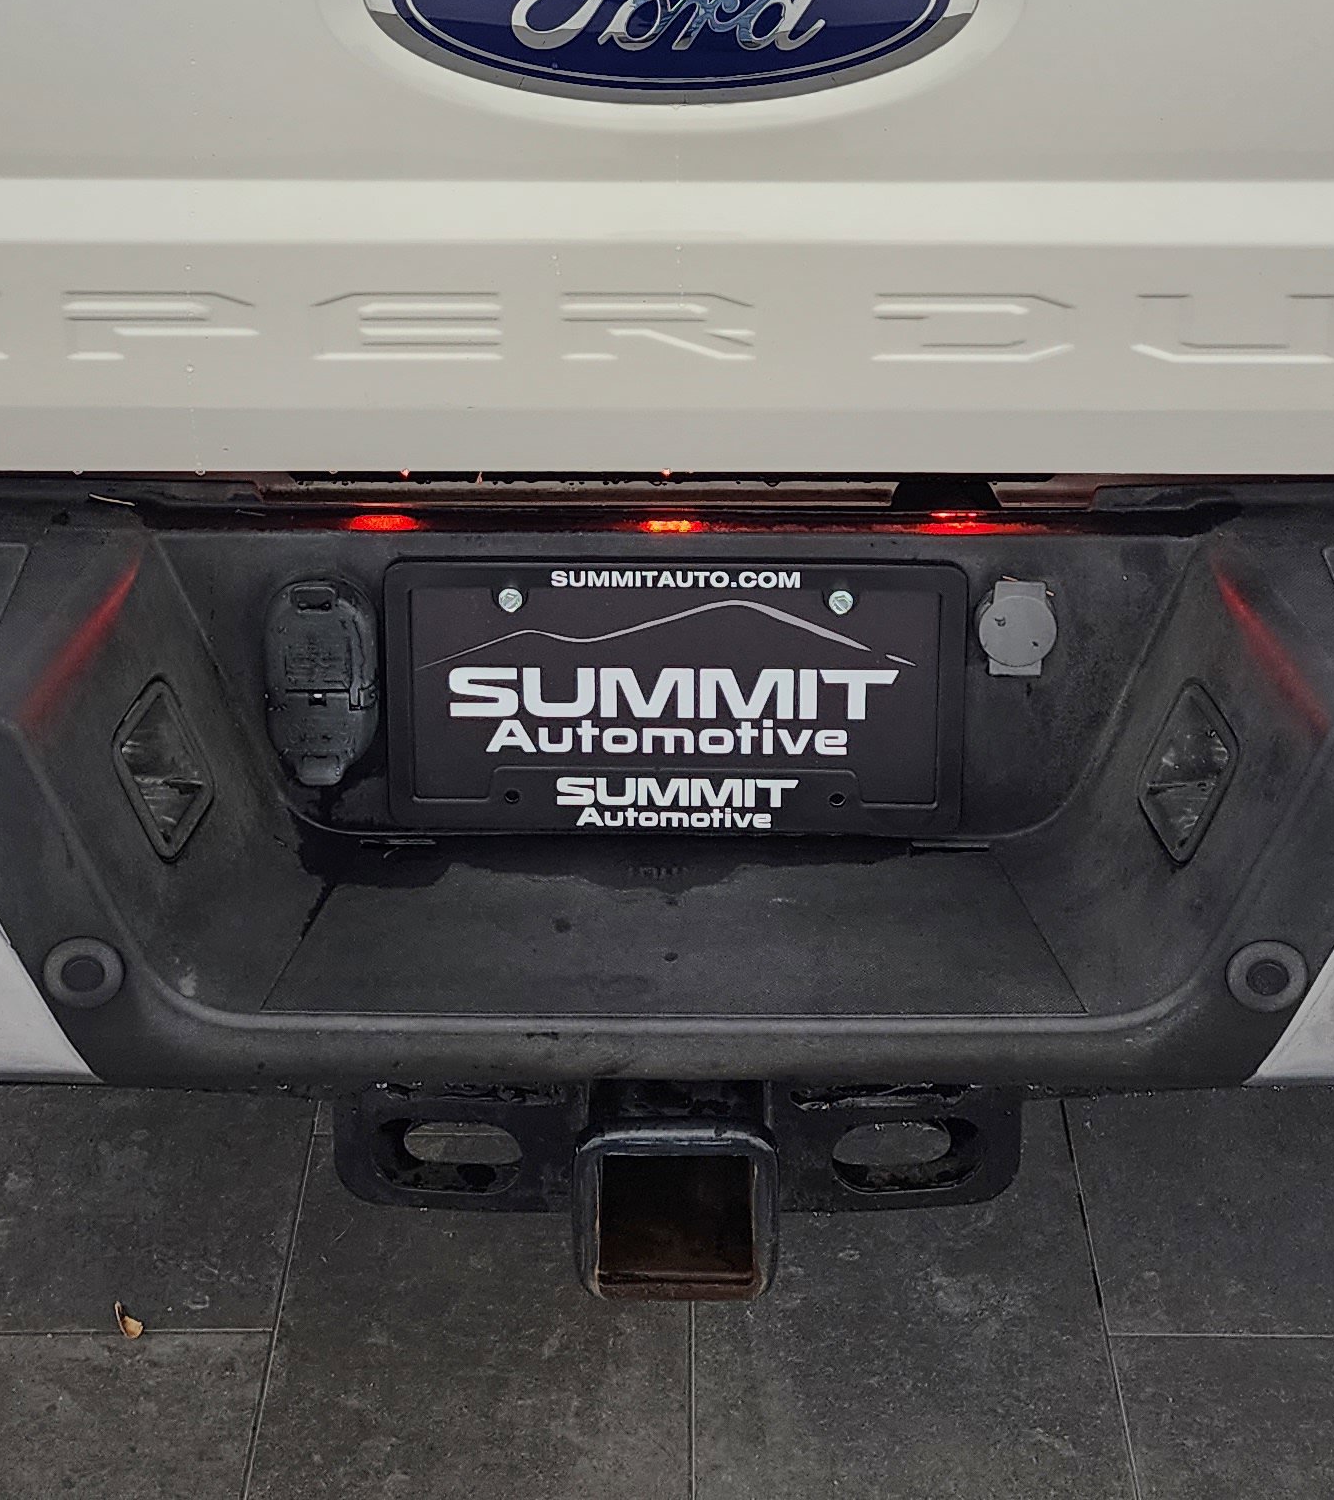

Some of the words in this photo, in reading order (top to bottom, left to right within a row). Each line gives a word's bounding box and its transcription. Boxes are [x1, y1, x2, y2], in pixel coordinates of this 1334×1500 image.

[550, 570, 802, 589] SUMMITAUTO.COM
[448, 666, 899, 721] SUMMIT
[485, 718, 849, 756] Automotive
[556, 776, 799, 809] SUMMIT
[575, 805, 773, 829] Automotive
